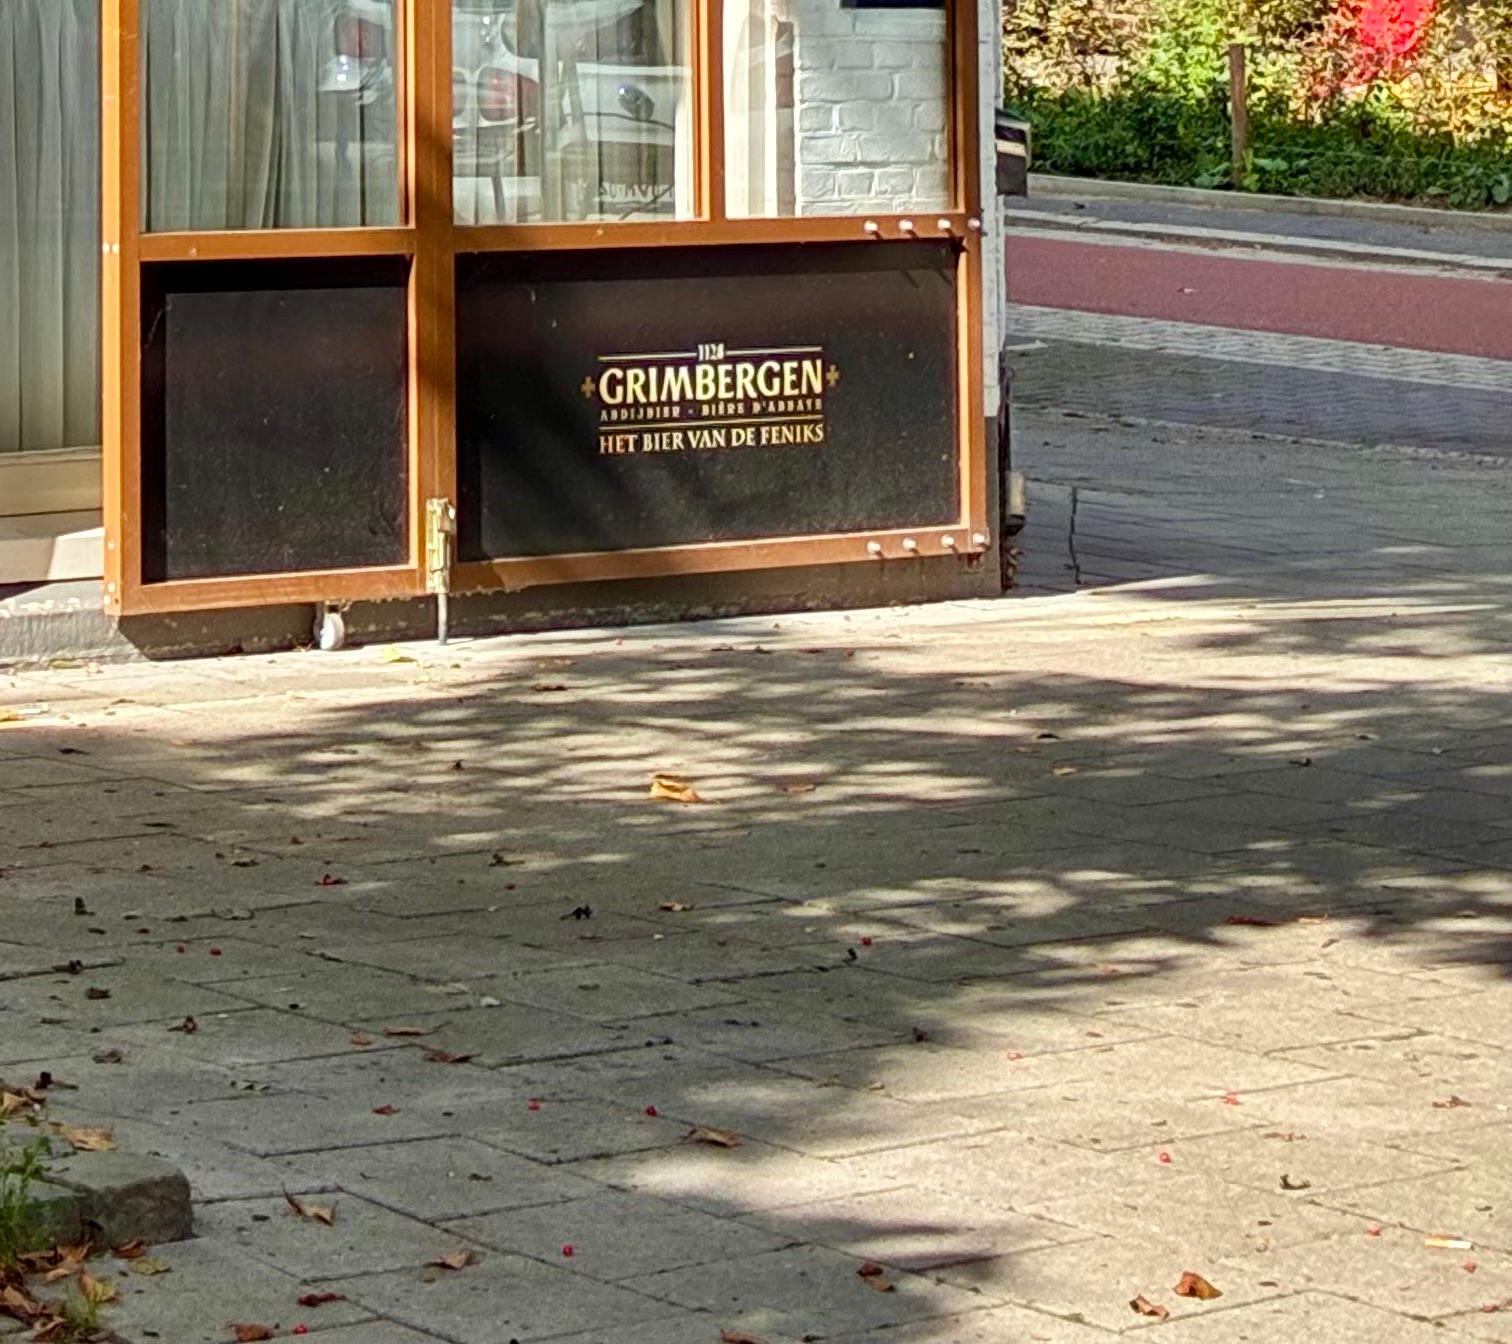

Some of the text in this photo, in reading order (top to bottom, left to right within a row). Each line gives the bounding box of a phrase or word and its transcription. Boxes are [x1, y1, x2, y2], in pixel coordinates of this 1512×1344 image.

[599, 360, 823, 404] GRIMBERGEN
[599, 423, 824, 454] HET BIER VAN DE FENIKS
